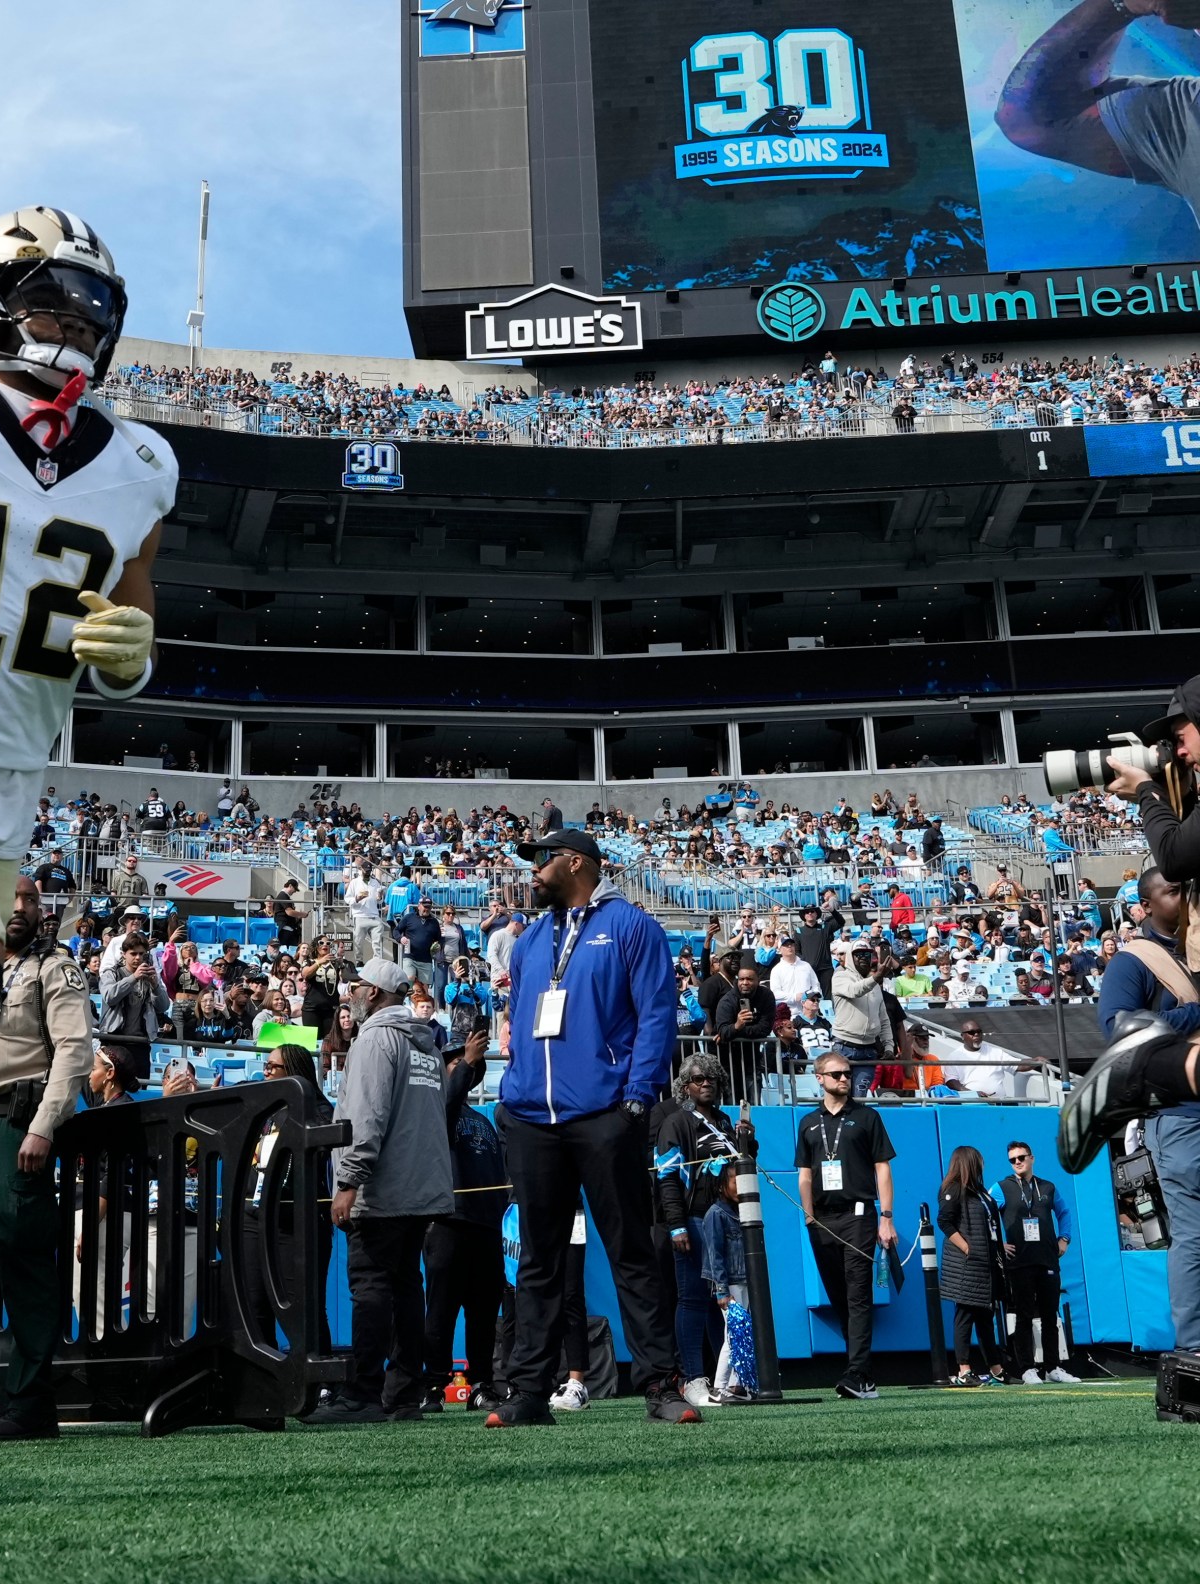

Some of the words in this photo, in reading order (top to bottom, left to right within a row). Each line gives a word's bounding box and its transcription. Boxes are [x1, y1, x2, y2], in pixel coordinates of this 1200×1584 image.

[690, 28, 861, 137] 30
[681, 151, 718, 167] 1995
[723, 138, 839, 168] SEASONS
[841, 143, 883, 157] 2024
[840, 284, 1038, 329] Atrium
[485, 310, 624, 350] LOWE'S
[981, 351, 1004, 364] 554
[634, 370, 657, 382] 553
[1029, 431, 1051, 442] QTR
[351, 443, 395, 473] 30
[1037, 450, 1048, 471] 1
[357, 475, 389, 483] SEASONS
[309, 783, 342, 800] 254
[148, 804, 165, 817] 59
[122, 880, 138, 895] 51
[861, 898, 876, 909] 55
[741, 934, 757, 948] 17
[800, 1028, 831, 1048] 22
[409, 1050, 440, 1070] BEST
